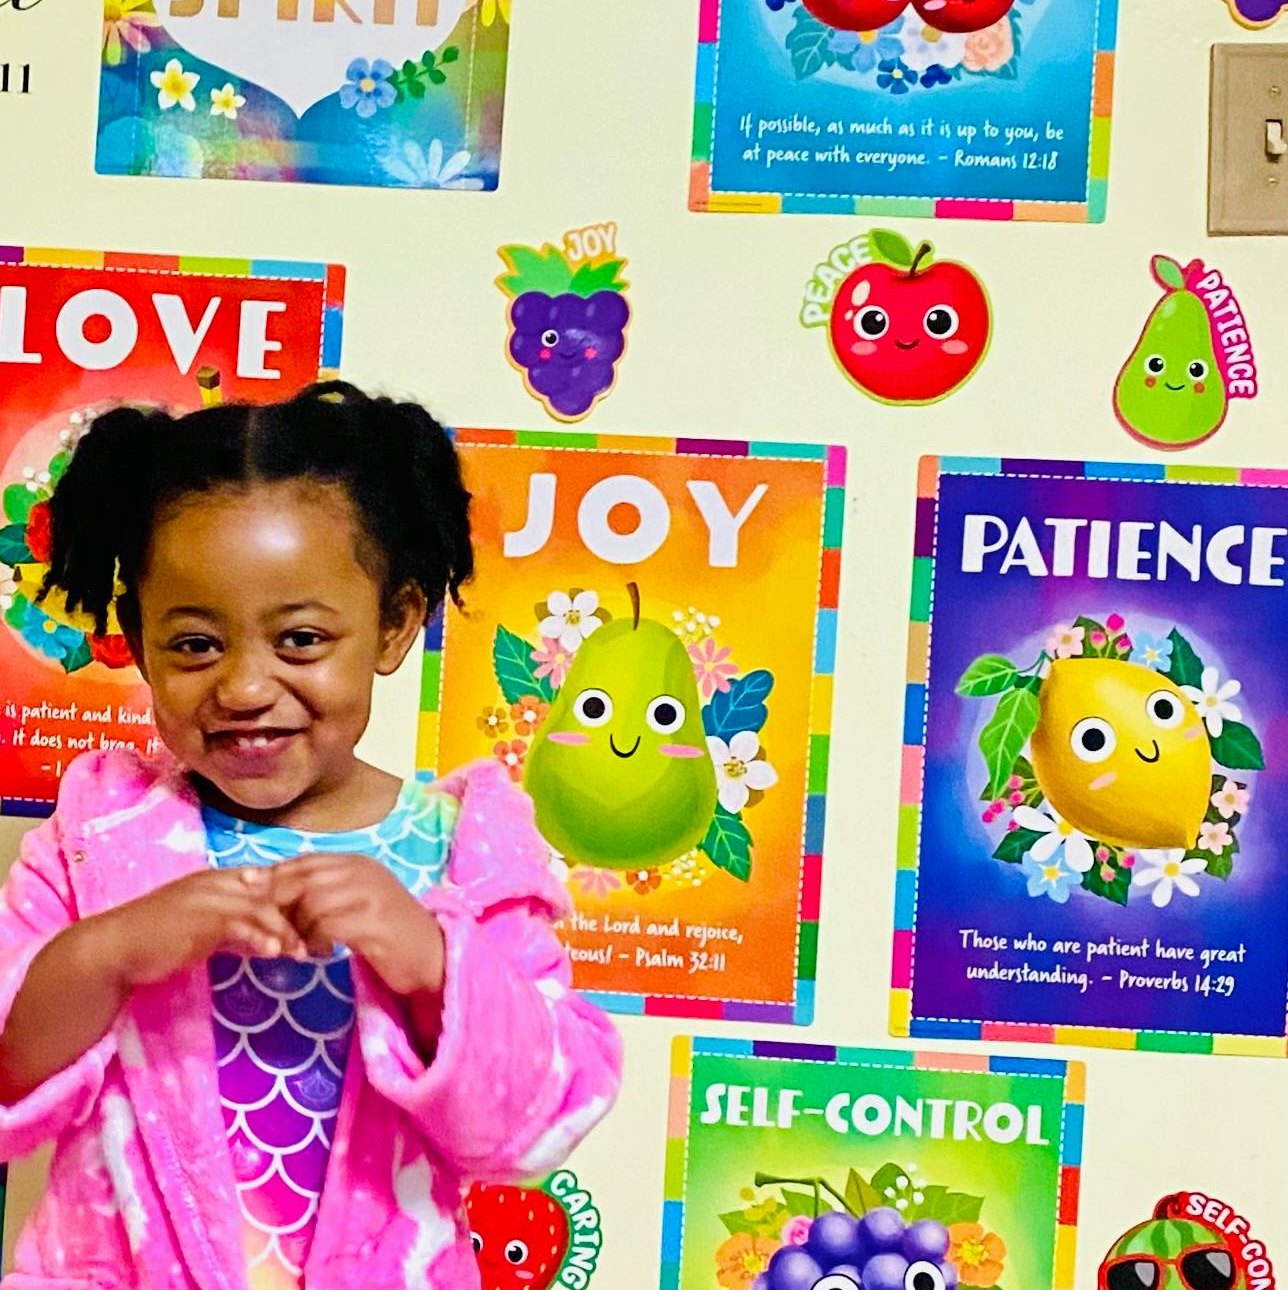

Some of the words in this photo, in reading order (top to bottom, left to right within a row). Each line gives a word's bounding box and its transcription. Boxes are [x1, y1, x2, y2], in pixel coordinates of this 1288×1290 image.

[740, 113, 752, 138] If
[758, 114, 821, 138] possible,
[827, 121, 843, 135] as
[849, 121, 893, 137] much
[898, 123, 915, 137] as
[920, 116, 935, 137] it
[940, 119, 952, 139] is
[957, 125, 977, 144] up
[983, 119, 999, 137] to
[1005, 127, 1039, 145] you,
[1046, 121, 1063, 140] be
[743, 143, 761, 160] at
[767, 150, 809, 168] peace
[815, 145, 850, 162] with
[856, 147, 930, 172] everyone.
[955, 149, 1017, 169] Romans
[1023, 151, 1058, 170] 12:18
[568, 225, 616, 261] JOY
[801, 239, 871, 326] PEACE
[1199, 273, 1255, 396] PATIENCE
[504, 473, 768, 567] JOY
[961, 515, 1288, 586] PATIENCE
[959, 929, 1008, 951] Those
[1014, 932, 1047, 951] who
[1052, 941, 1081, 954] are
[1087, 936, 1150, 962] patient
[1156, 939, 1194, 960] have
[1200, 943, 1246, 969] great
[967, 961, 1093, 993] understanding.
[1119, 969, 1188, 992] Proverbs
[1195, 974, 1234, 997] 14:29
[700, 1083, 1049, 1145] SELF-CONTROL
[550, 1171, 600, 1290] CARING
